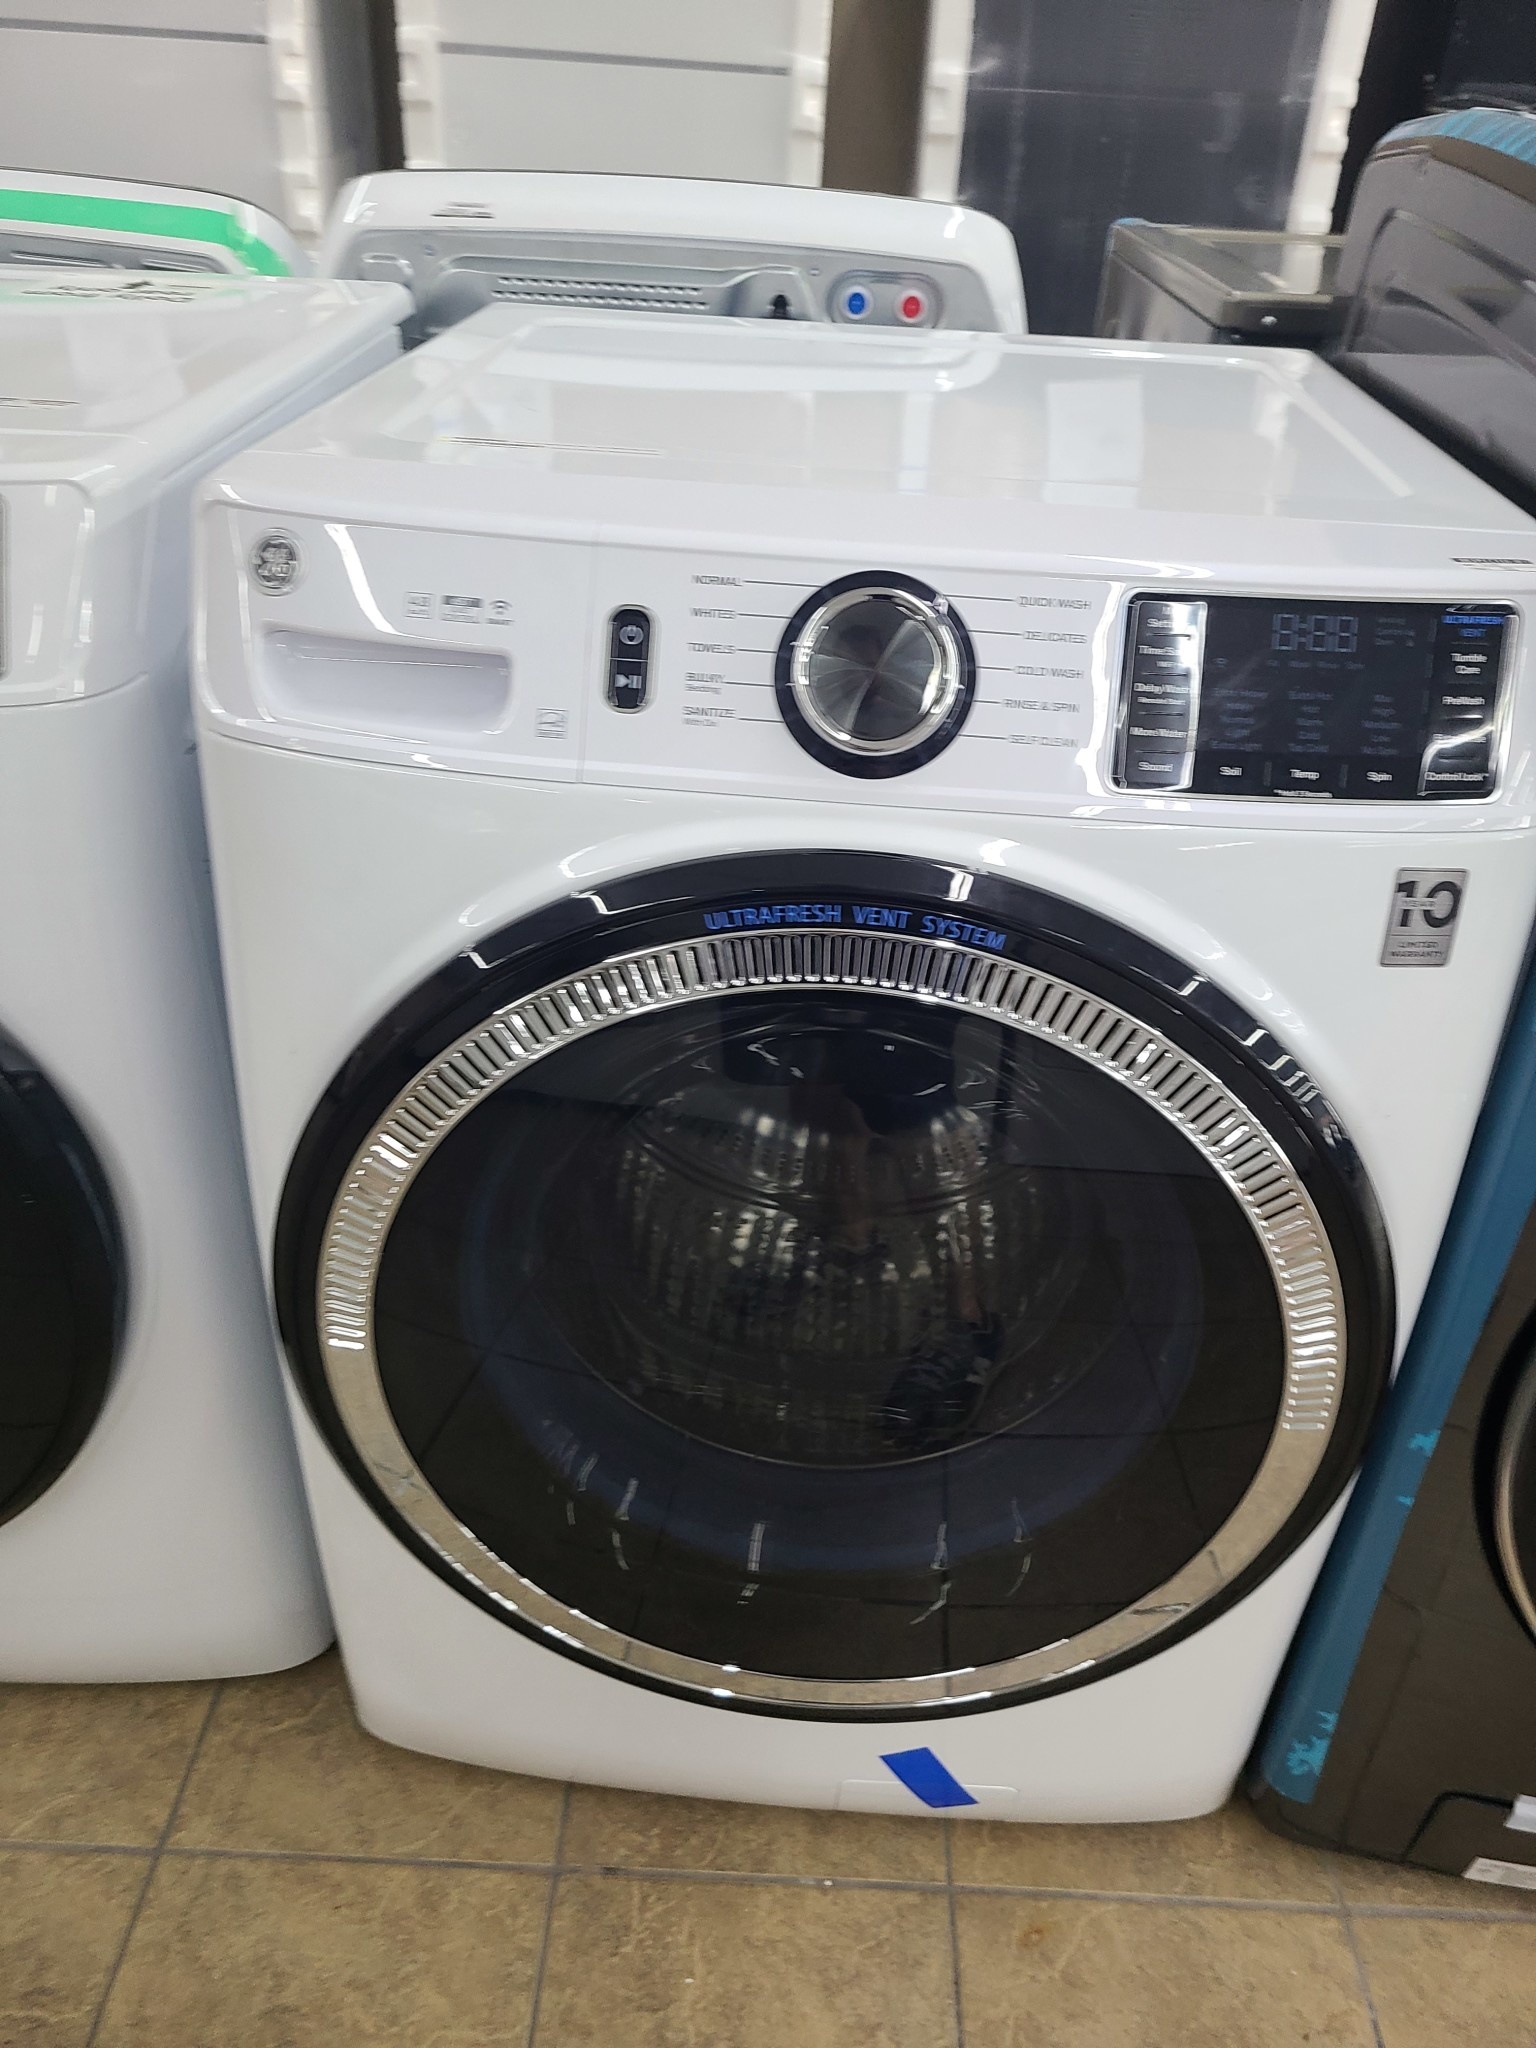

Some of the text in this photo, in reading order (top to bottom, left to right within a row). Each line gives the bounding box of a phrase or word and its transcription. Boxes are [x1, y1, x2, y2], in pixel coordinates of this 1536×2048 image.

[691, 574, 742, 587] NORMAL
[1017, 596, 1092, 610] QUICK WASH
[690, 607, 737, 620] WHITES
[1024, 630, 1088, 644] DELICATES
[687, 642, 737, 655] TOWELS
[1014, 665, 1085, 679] COLD WASH
[682, 705, 736, 718] SANITIZE
[1003, 699, 1039, 710] RINSE
[1053, 702, 1080, 714] SPIN
[1008, 734, 1079, 748] SELF CLEAN
[1219, 766, 1243, 776] Soil
[1290, 769, 1320, 781] Temp
[1366, 771, 1393, 783] Spin
[1395, 880, 1462, 929] 10
[703, 904, 1007, 951] ULTRAFRESH VENT SYSTEM
